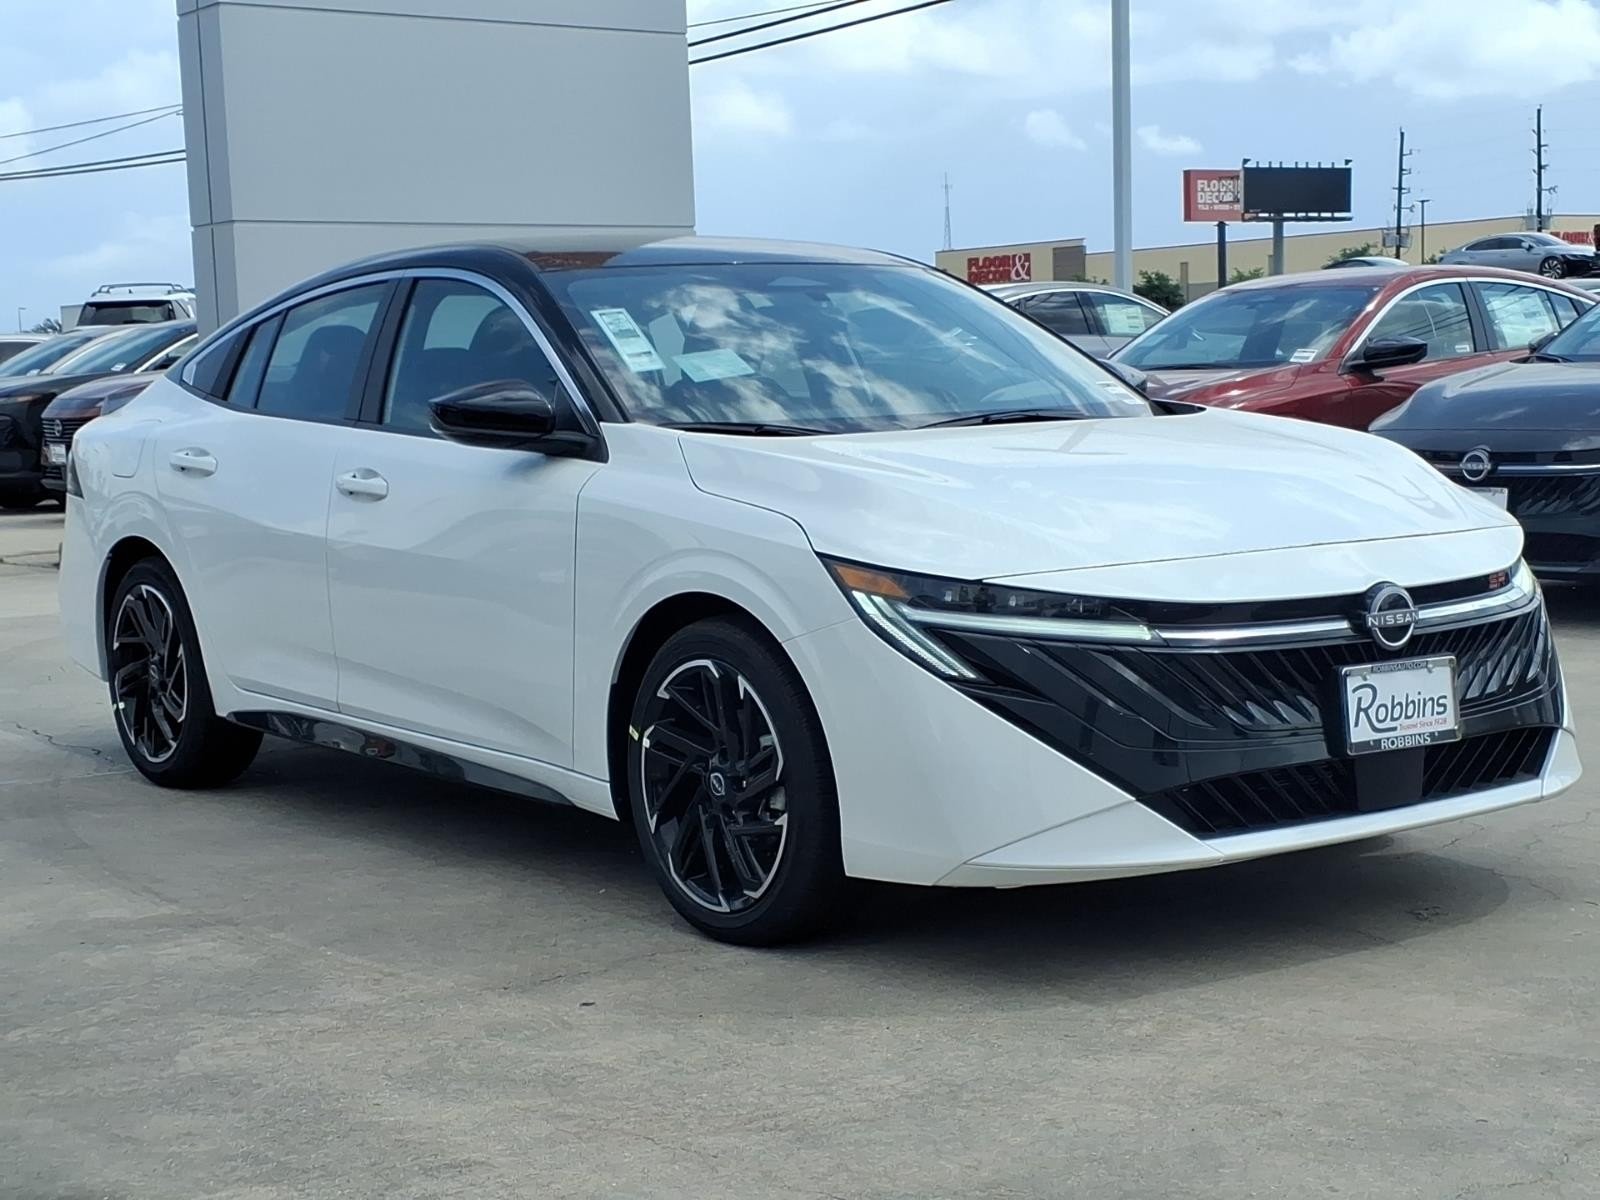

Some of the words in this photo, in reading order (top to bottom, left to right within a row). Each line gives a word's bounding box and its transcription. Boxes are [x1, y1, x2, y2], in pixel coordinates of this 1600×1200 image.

[967, 255, 1010, 271] FLOOR
[1368, 611, 1419, 626] NISSAN
[1352, 683, 1448, 733] Robbins
[1381, 733, 1431, 749] ROBBINS
